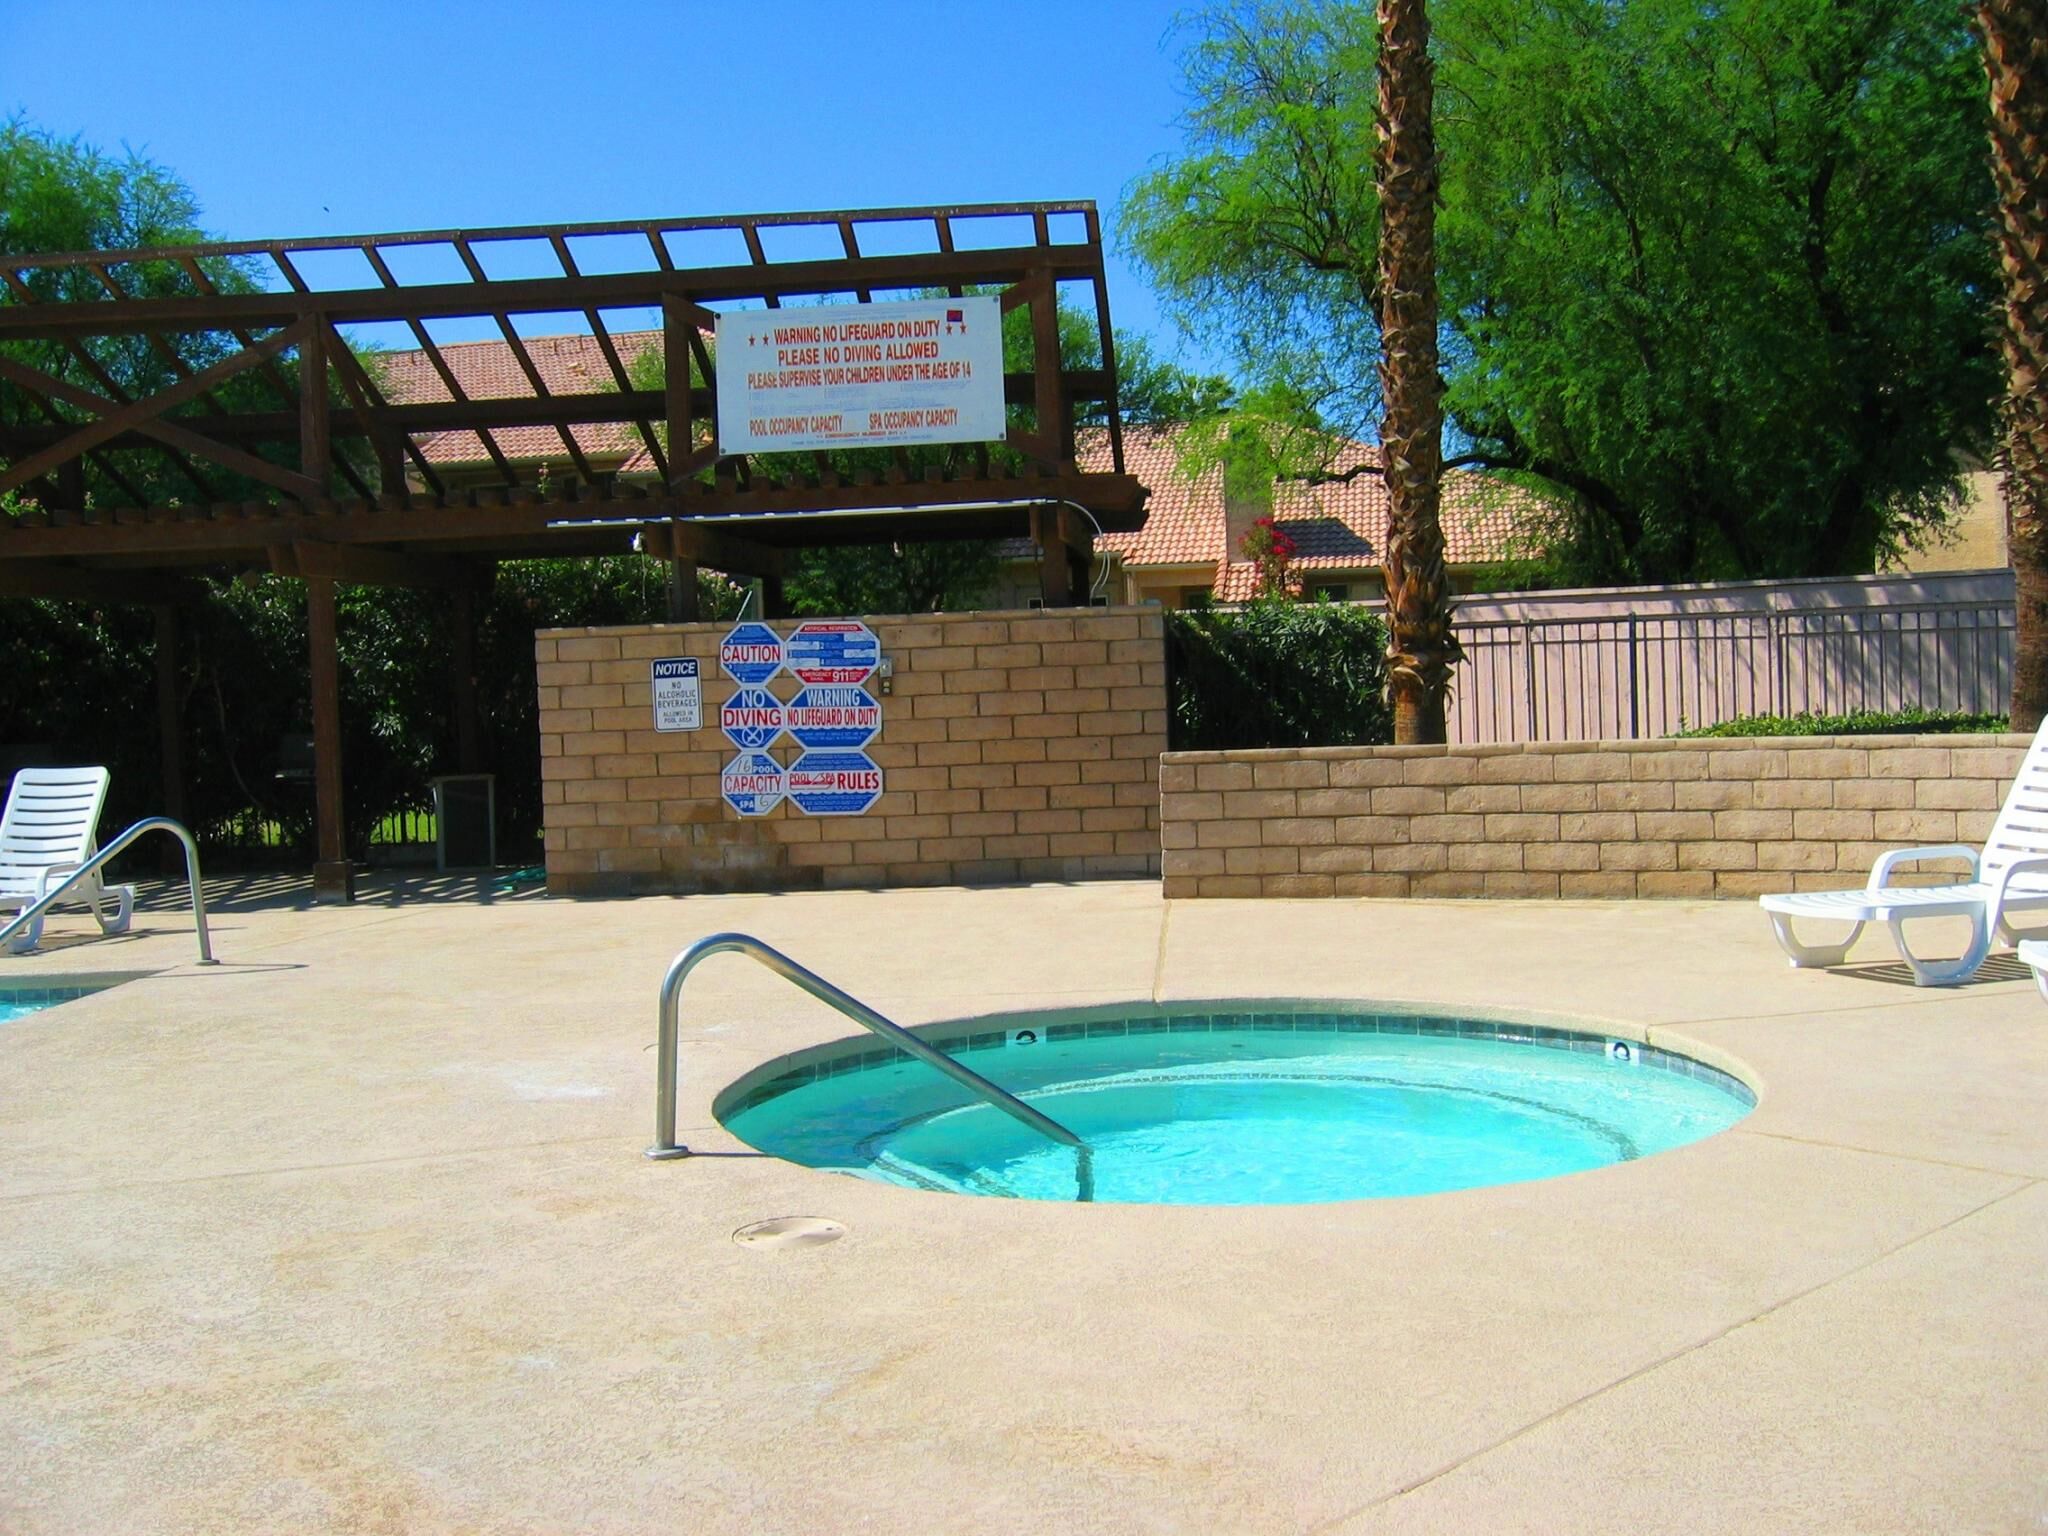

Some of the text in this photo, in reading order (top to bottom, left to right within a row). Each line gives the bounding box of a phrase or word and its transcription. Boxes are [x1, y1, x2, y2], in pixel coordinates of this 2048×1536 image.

[774, 320, 940, 345] WARNING NO LIFEGUARD ON DUTY
[778, 342, 938, 366] PLEASE NO DIVING ALLOWED
[748, 361, 971, 389] PLEASE SUPERVISE YOUR CHILDREN UNDER THE AGE OF 14
[750, 415, 842, 436] POOL OCCUPANCY CAPACITY
[869, 408, 958, 430] SPA OCCUPANCY CAPACITY
[722, 646, 780, 662] CAUTION
[656, 662, 696, 676] NOTICE
[832, 672, 849, 682] 911
[658, 690, 696, 699] ALCOHOLIC
[658, 698, 697, 708] BEVERAGES
[742, 690, 765, 708] NO
[806, 689, 860, 706] WARNING
[723, 709, 782, 726] DIVING
[788, 708, 878, 726] NO LIFEGUARD ON DUTY
[737, 759, 750, 773] 16
[724, 776, 782, 792] CAPACITY
[790, 773, 809, 784] POOL
[837, 772, 879, 790] RULES
[739, 800, 754, 808] SPA
